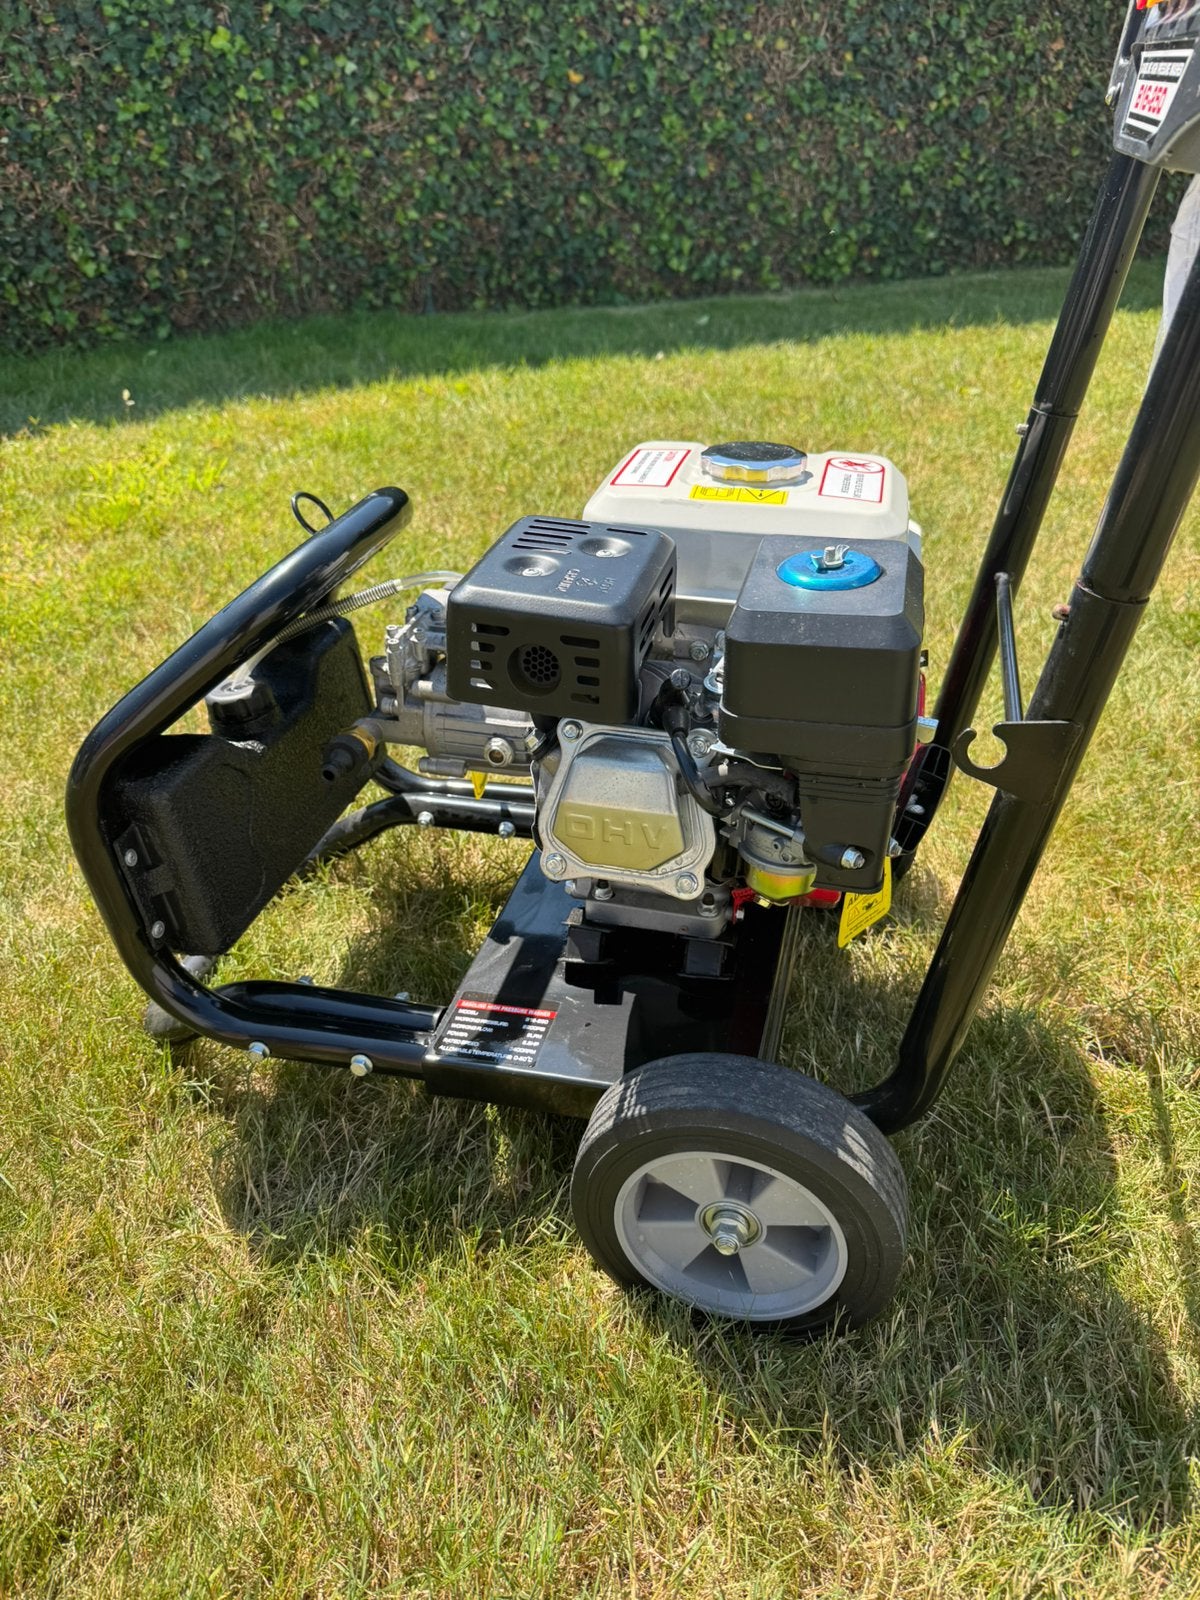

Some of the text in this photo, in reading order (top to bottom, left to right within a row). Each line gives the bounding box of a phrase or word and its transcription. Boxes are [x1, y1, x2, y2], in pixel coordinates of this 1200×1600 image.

[566, 813, 667, 849] OHV
[461, 1001, 550, 1017] GASOLINE HIGH PRESSURE WASHER
